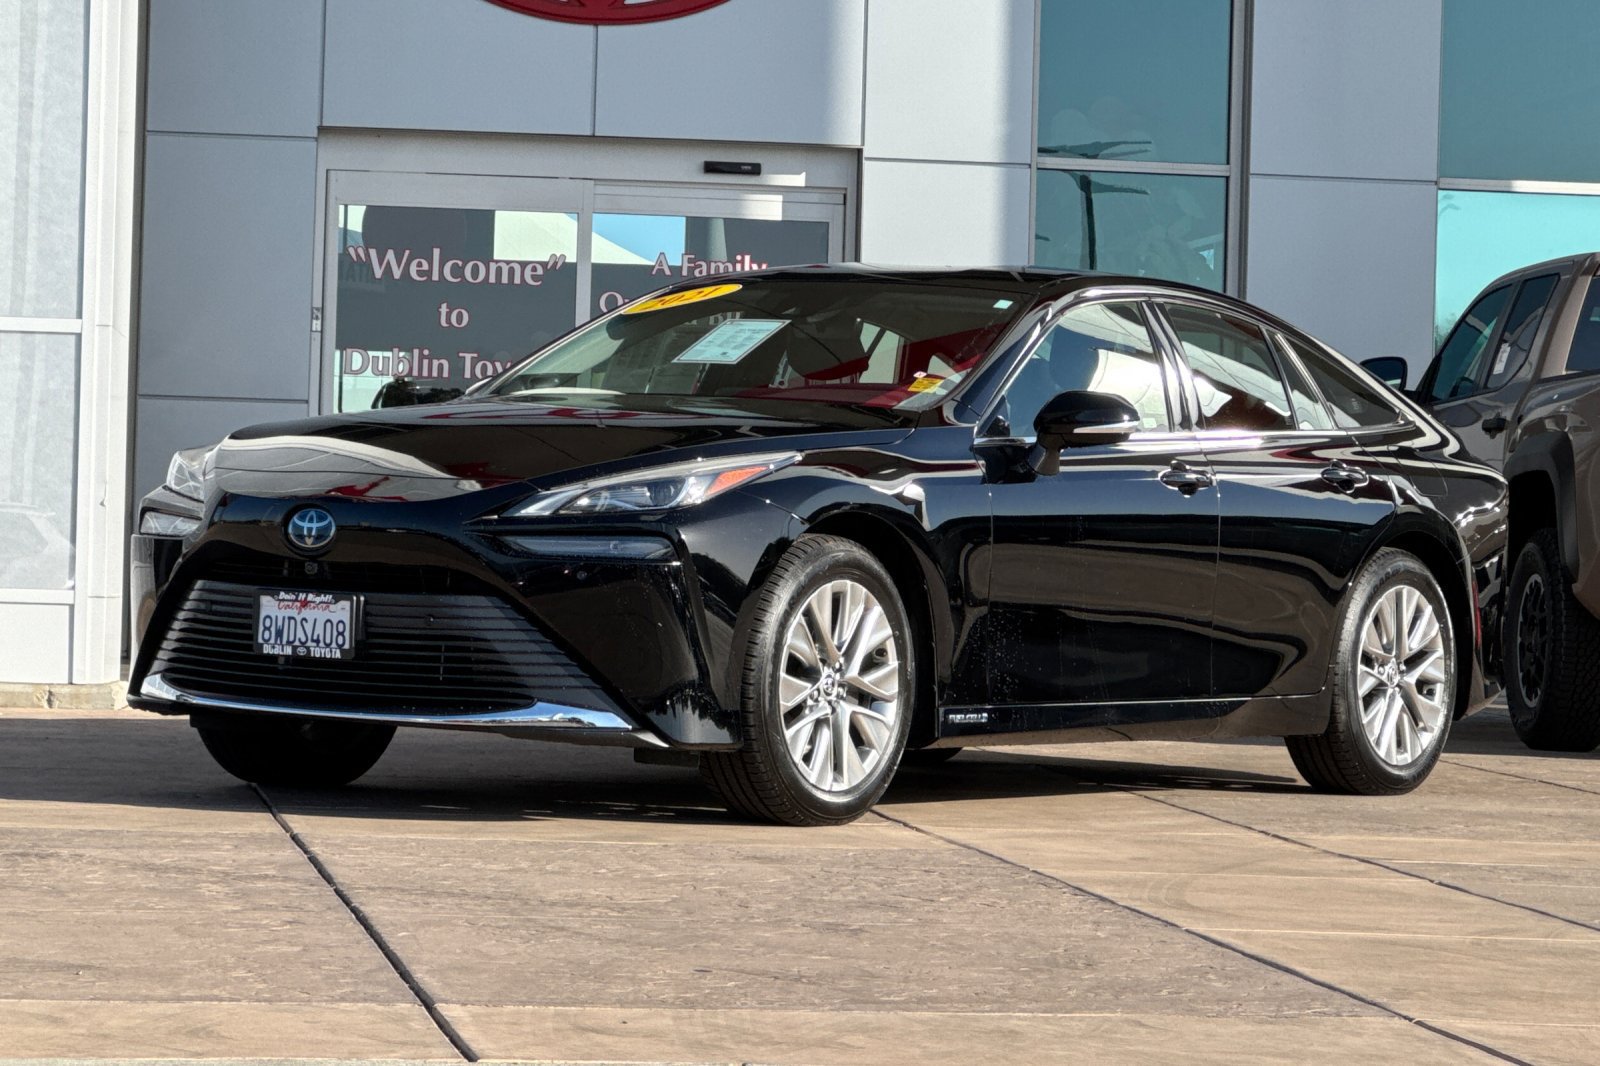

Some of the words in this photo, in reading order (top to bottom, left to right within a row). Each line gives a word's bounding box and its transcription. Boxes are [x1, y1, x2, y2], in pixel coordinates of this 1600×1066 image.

[651, 252, 672, 276] A
[438, 302, 470, 328] to
[343, 347, 450, 378] Dublin
[261, 614, 347, 649] 8WDS408
[262, 643, 292, 656] DUBLIN
[309, 646, 342, 659] TOYOTA
